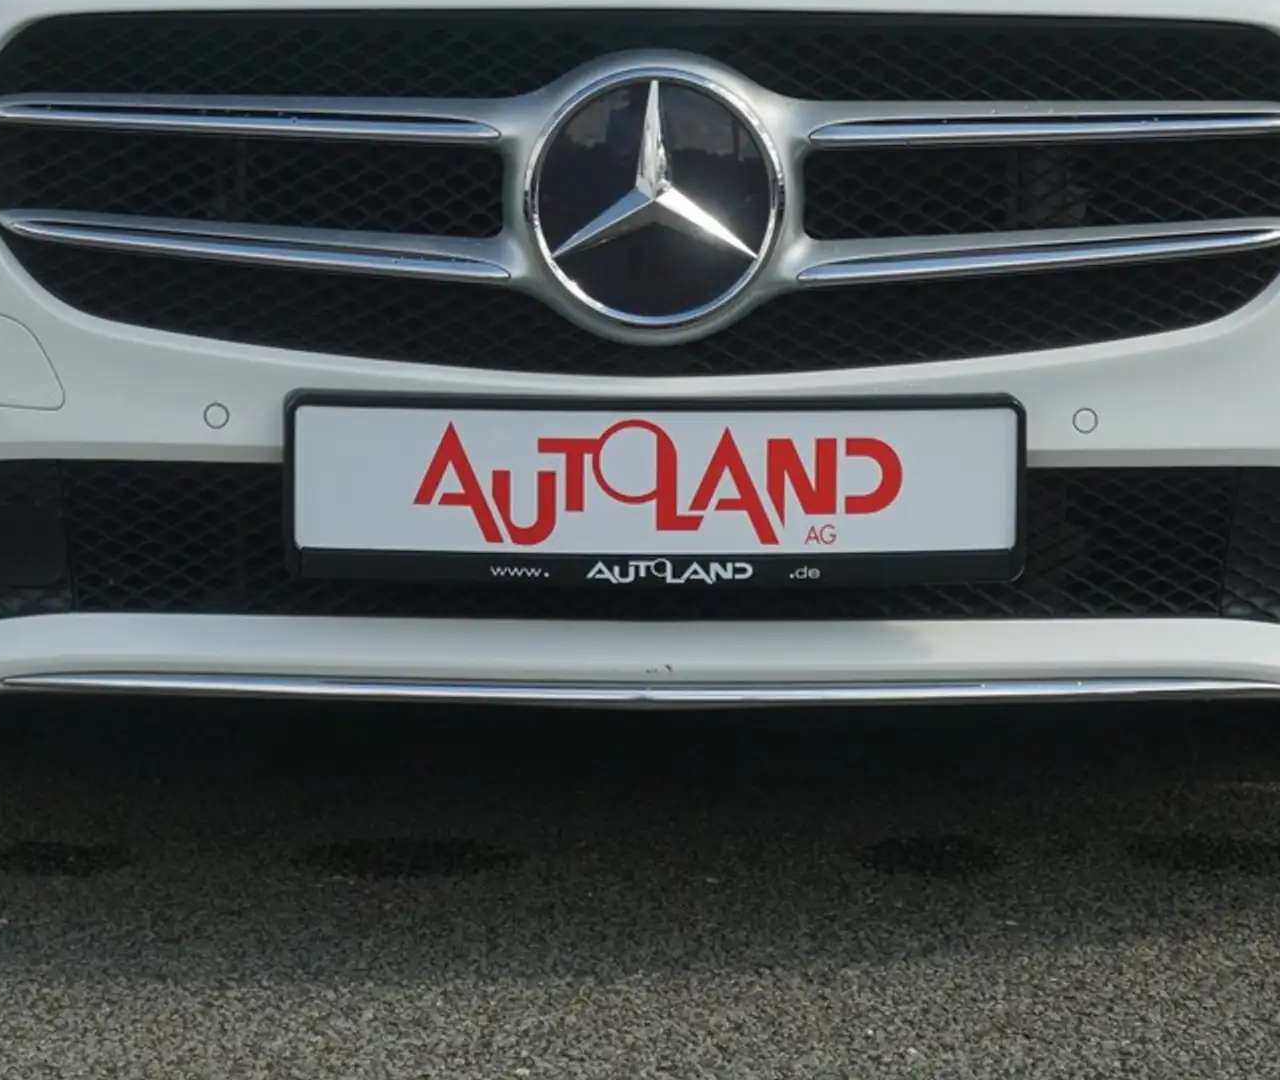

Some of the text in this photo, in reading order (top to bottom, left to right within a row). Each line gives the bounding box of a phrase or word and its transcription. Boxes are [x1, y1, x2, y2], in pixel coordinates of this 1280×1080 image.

[413, 418, 904, 546] AUTOLAND
[804, 523, 837, 545] AG
[586, 558, 754, 585] AUTOLAND
